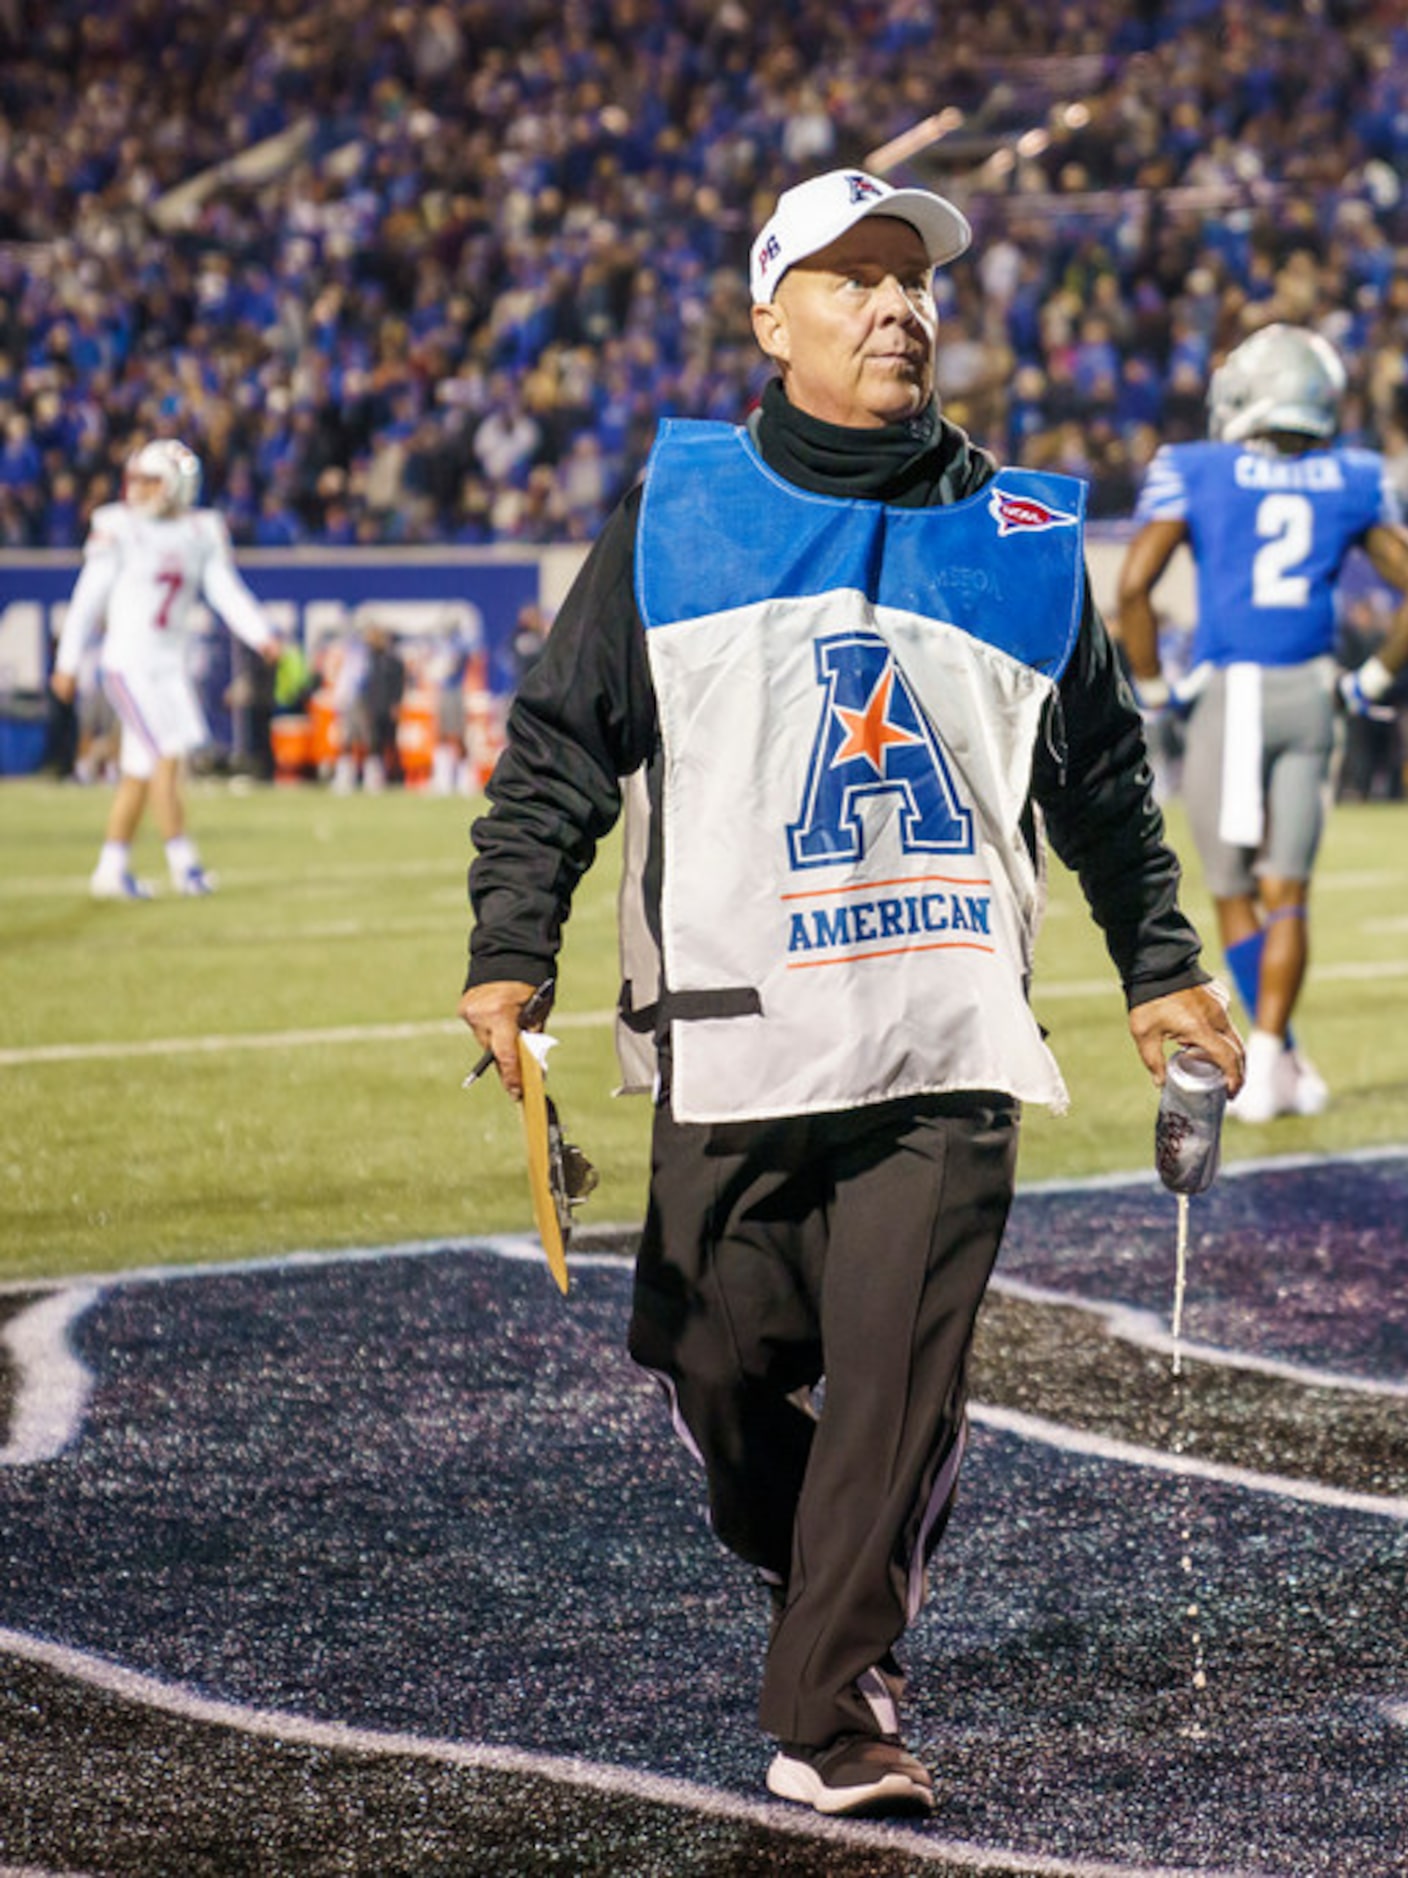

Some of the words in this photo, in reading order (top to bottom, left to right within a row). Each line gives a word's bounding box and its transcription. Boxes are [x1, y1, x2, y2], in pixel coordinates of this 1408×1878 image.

[1252, 492, 1315, 608] 2
[151, 571, 186, 629] 7
[787, 894, 992, 952] AMERICAN
